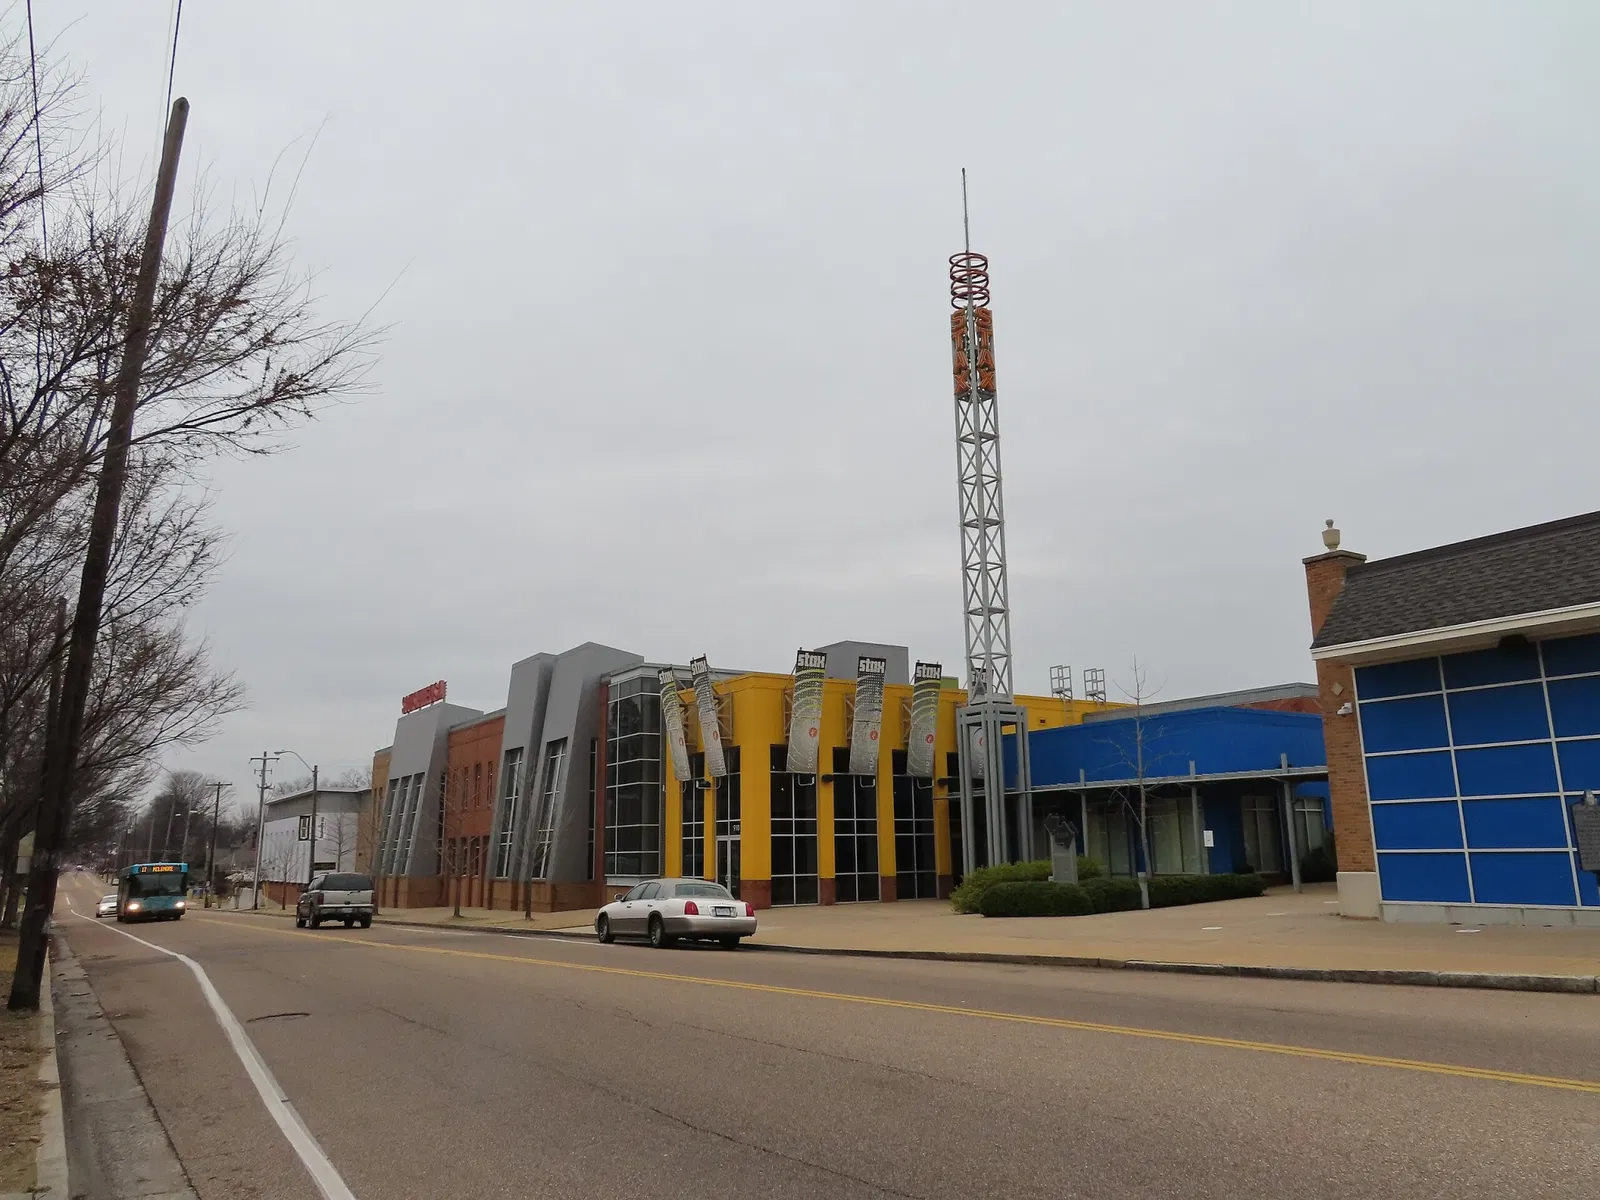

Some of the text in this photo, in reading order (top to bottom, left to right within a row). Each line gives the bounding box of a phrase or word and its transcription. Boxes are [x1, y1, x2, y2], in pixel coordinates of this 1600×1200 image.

[951, 309, 971, 394] STAX
[974, 307, 996, 393] STAX
[797, 652, 825, 669] stax
[858, 658, 885, 674] stax
[915, 664, 941, 679] stax
